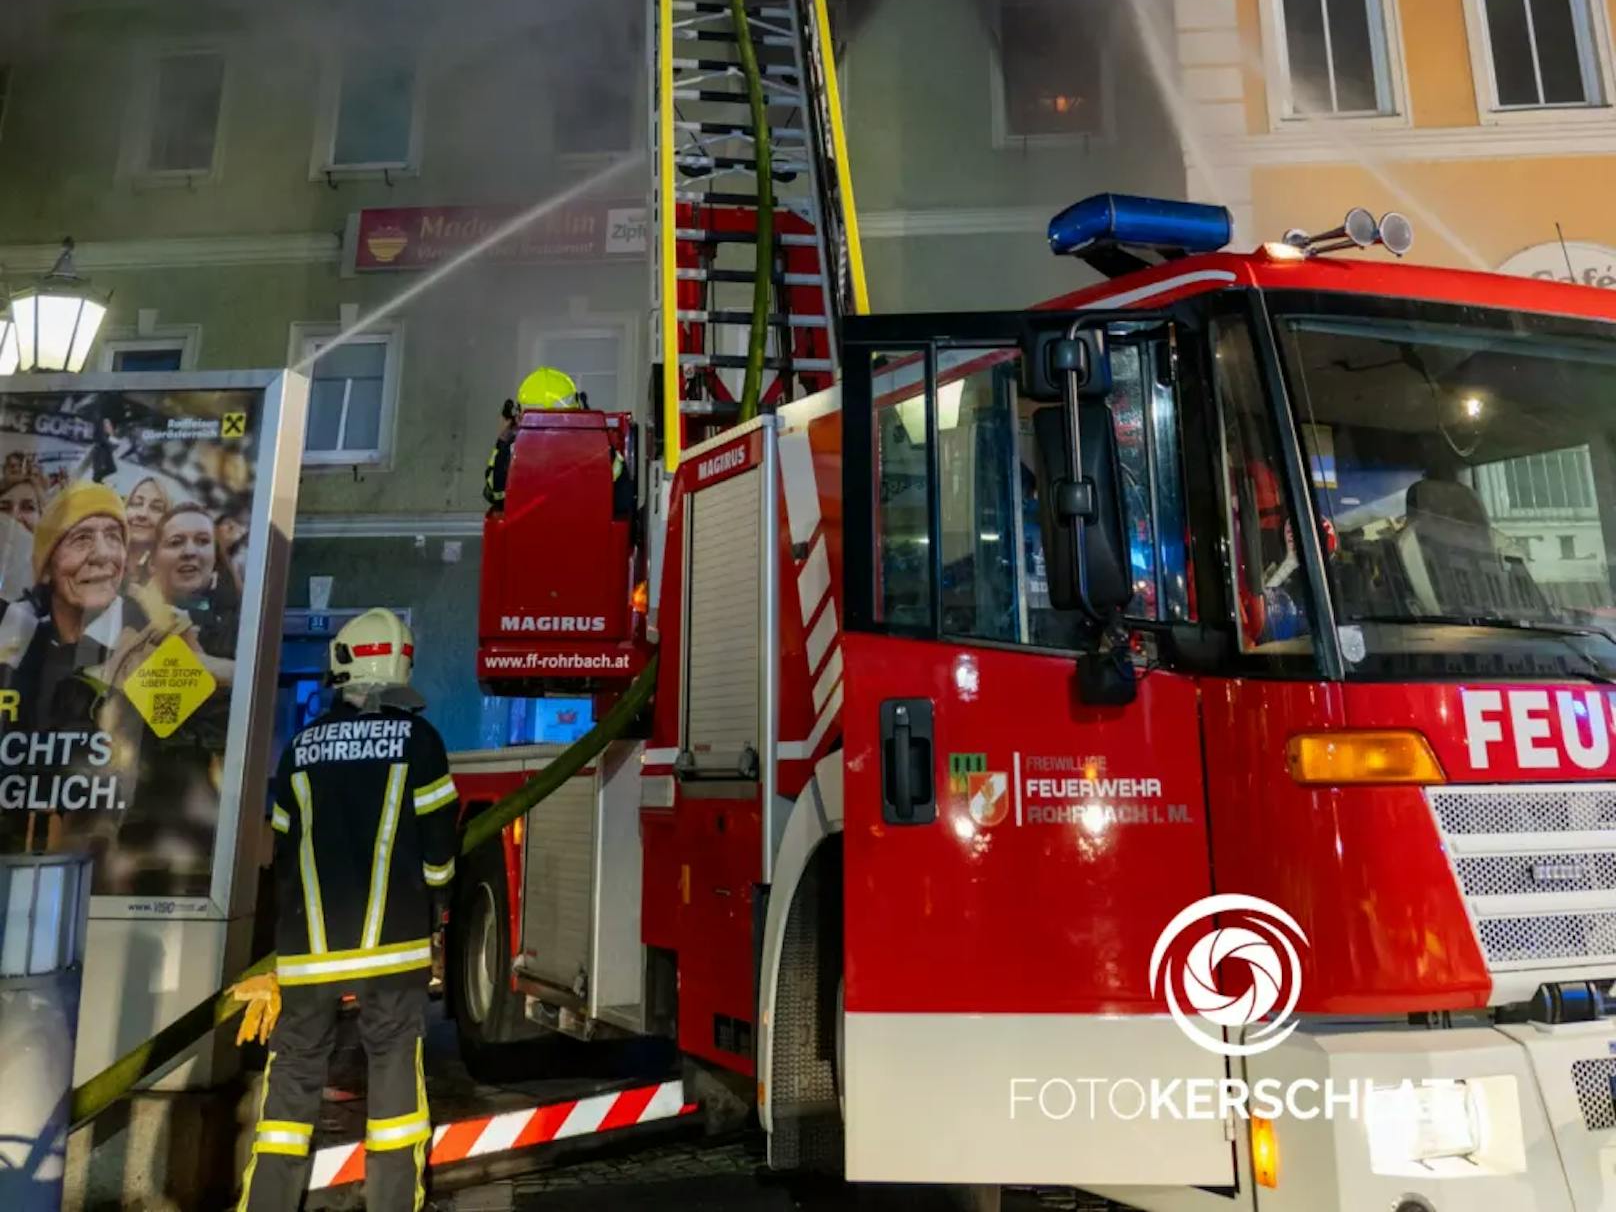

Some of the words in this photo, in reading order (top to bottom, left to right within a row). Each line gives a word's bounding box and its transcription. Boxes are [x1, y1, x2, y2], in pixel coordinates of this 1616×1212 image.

[698, 444, 746, 481] MAGIRUS
[501, 616, 606, 631] MAGIRUS
[485, 653, 630, 669] www.ff-rohrbach.at
[1461, 690, 1616, 770] FEU
[294, 739, 404, 767] ROHRBACH
[1026, 778, 1162, 797] FEUERWEHR
